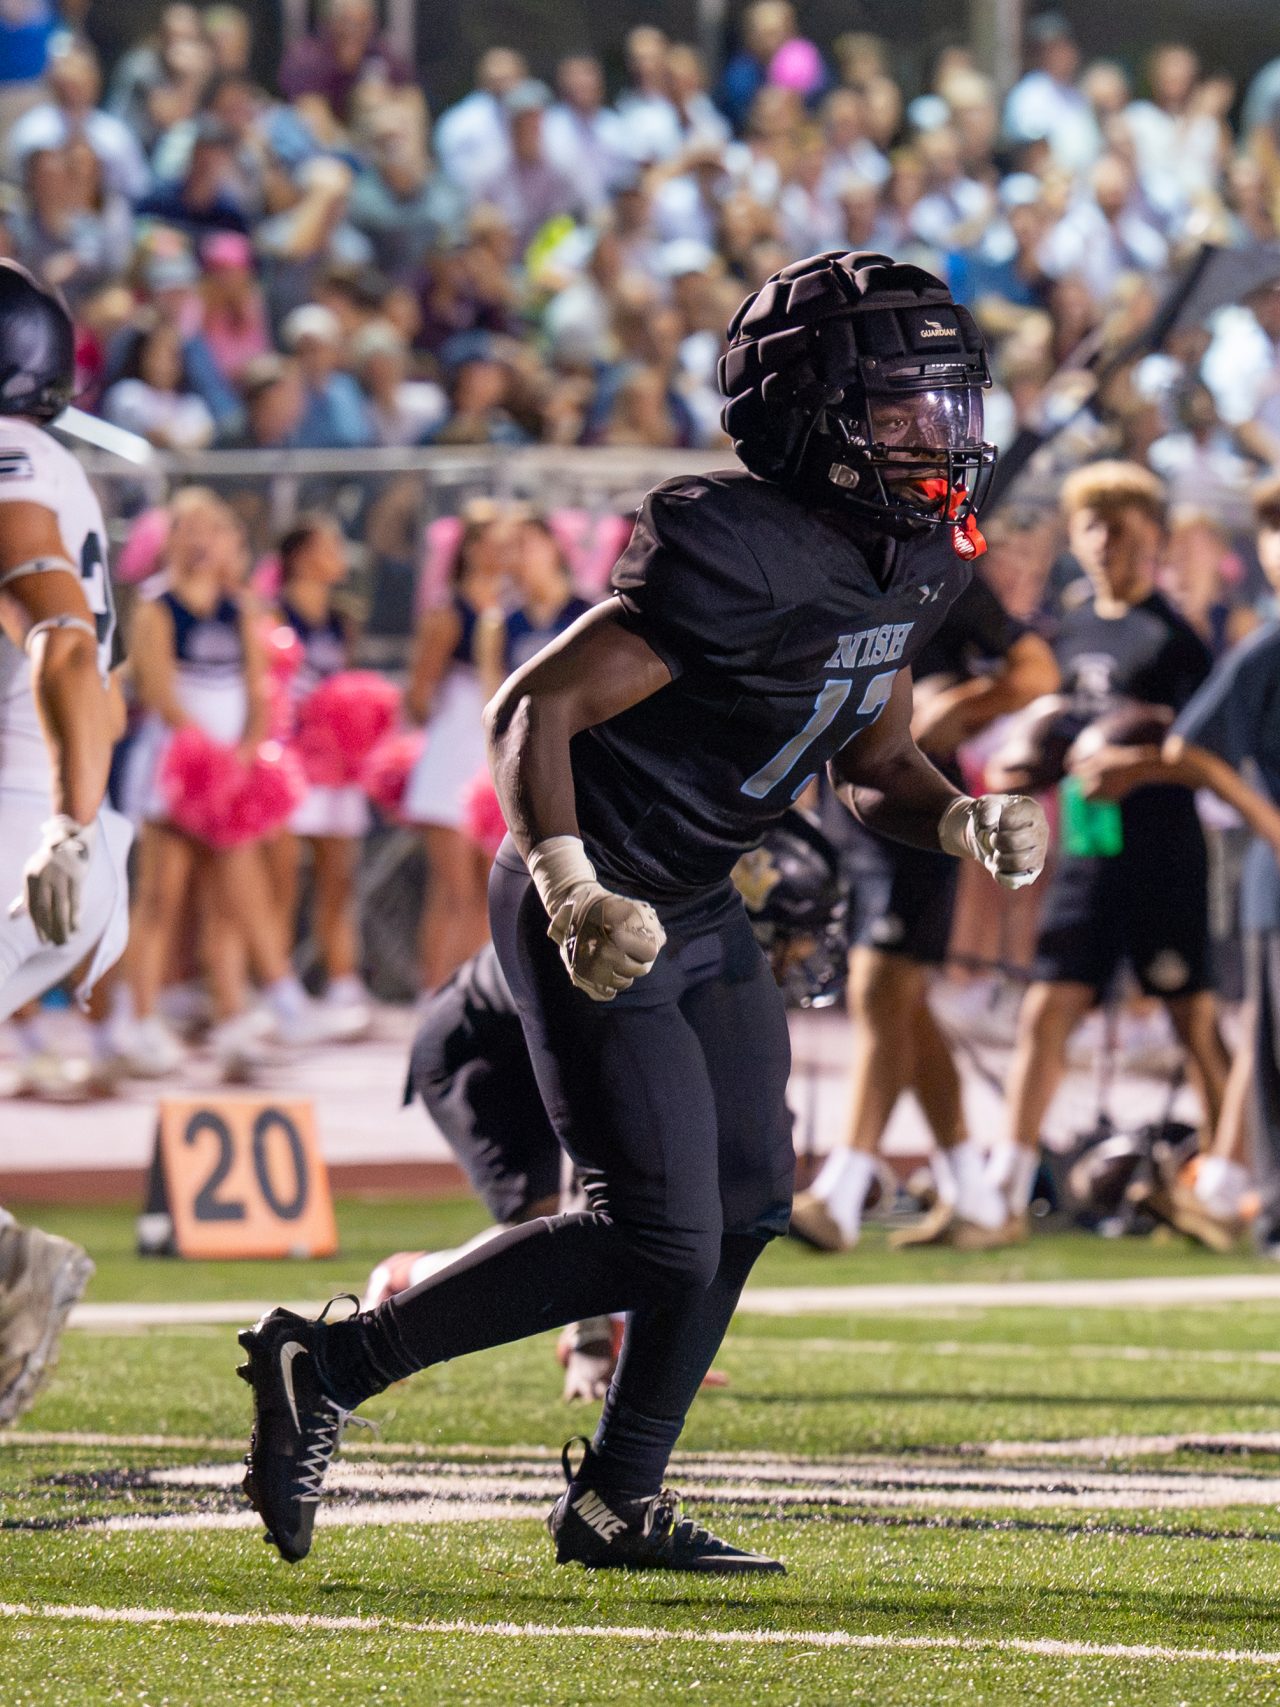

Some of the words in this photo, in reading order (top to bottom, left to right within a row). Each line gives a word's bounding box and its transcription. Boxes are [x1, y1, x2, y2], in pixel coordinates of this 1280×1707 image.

[920, 328, 957, 338] GUARDIAN
[185, 1110, 308, 1220] 20
[572, 1489, 628, 1545] NIKE
